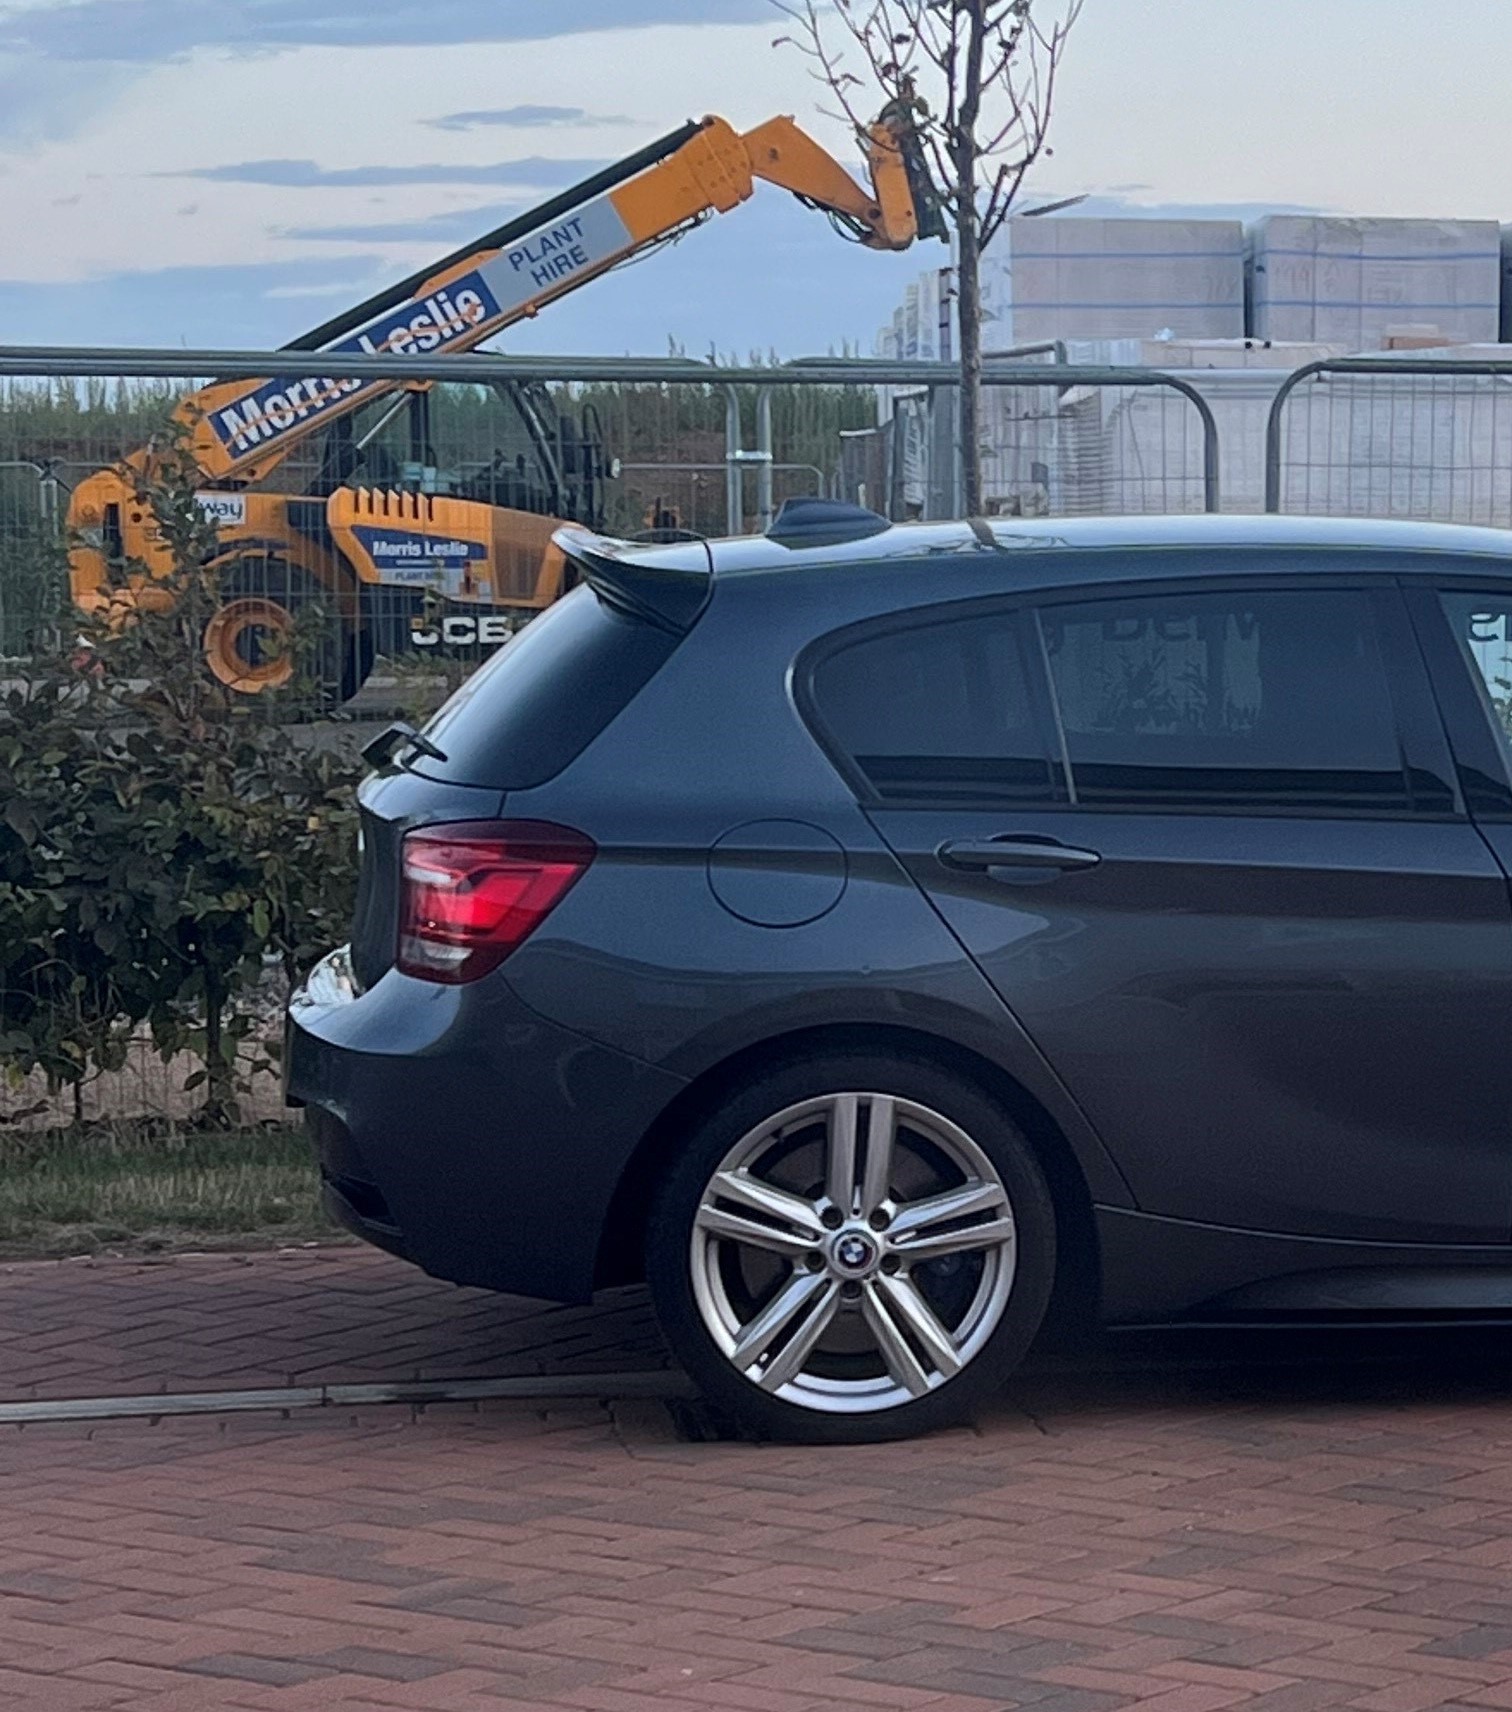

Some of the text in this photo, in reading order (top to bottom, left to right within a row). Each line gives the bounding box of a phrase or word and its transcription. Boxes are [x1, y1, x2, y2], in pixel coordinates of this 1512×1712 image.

[508, 216, 584, 272] PLANT
[530, 244, 589, 287] HIRE
[372, 540, 469, 557] Morris Leslie
